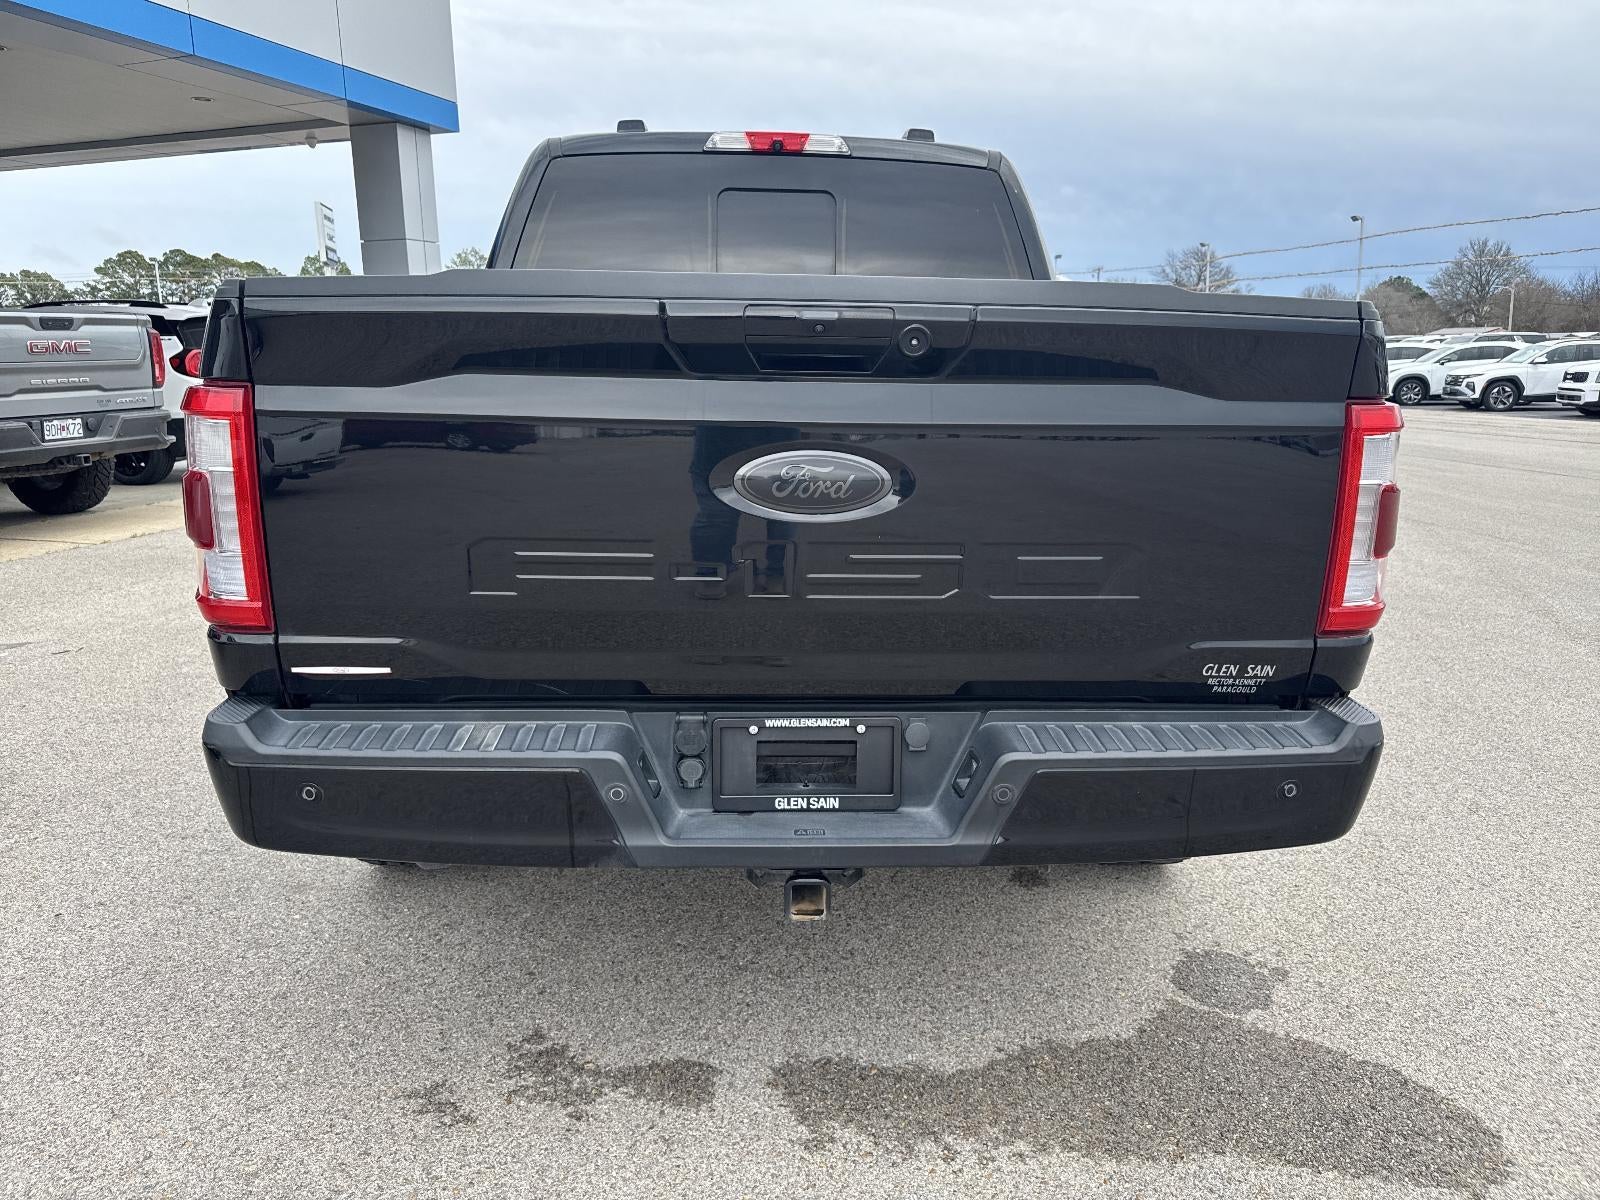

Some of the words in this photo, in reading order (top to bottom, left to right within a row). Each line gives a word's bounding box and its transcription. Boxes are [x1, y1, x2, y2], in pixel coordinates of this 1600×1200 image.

[27, 340, 92, 355] GMC
[66, 422, 83, 436] K72
[772, 464, 856, 499] Ford
[466, 536, 1147, 600] F-150
[1203, 664, 1239, 676] GLEN
[1245, 665, 1276, 676] SAIN
[765, 718, 850, 727] WWW.GLENSAIN.COM
[775, 798, 807, 809] GLEN
[809, 797, 839, 809] SAIN
